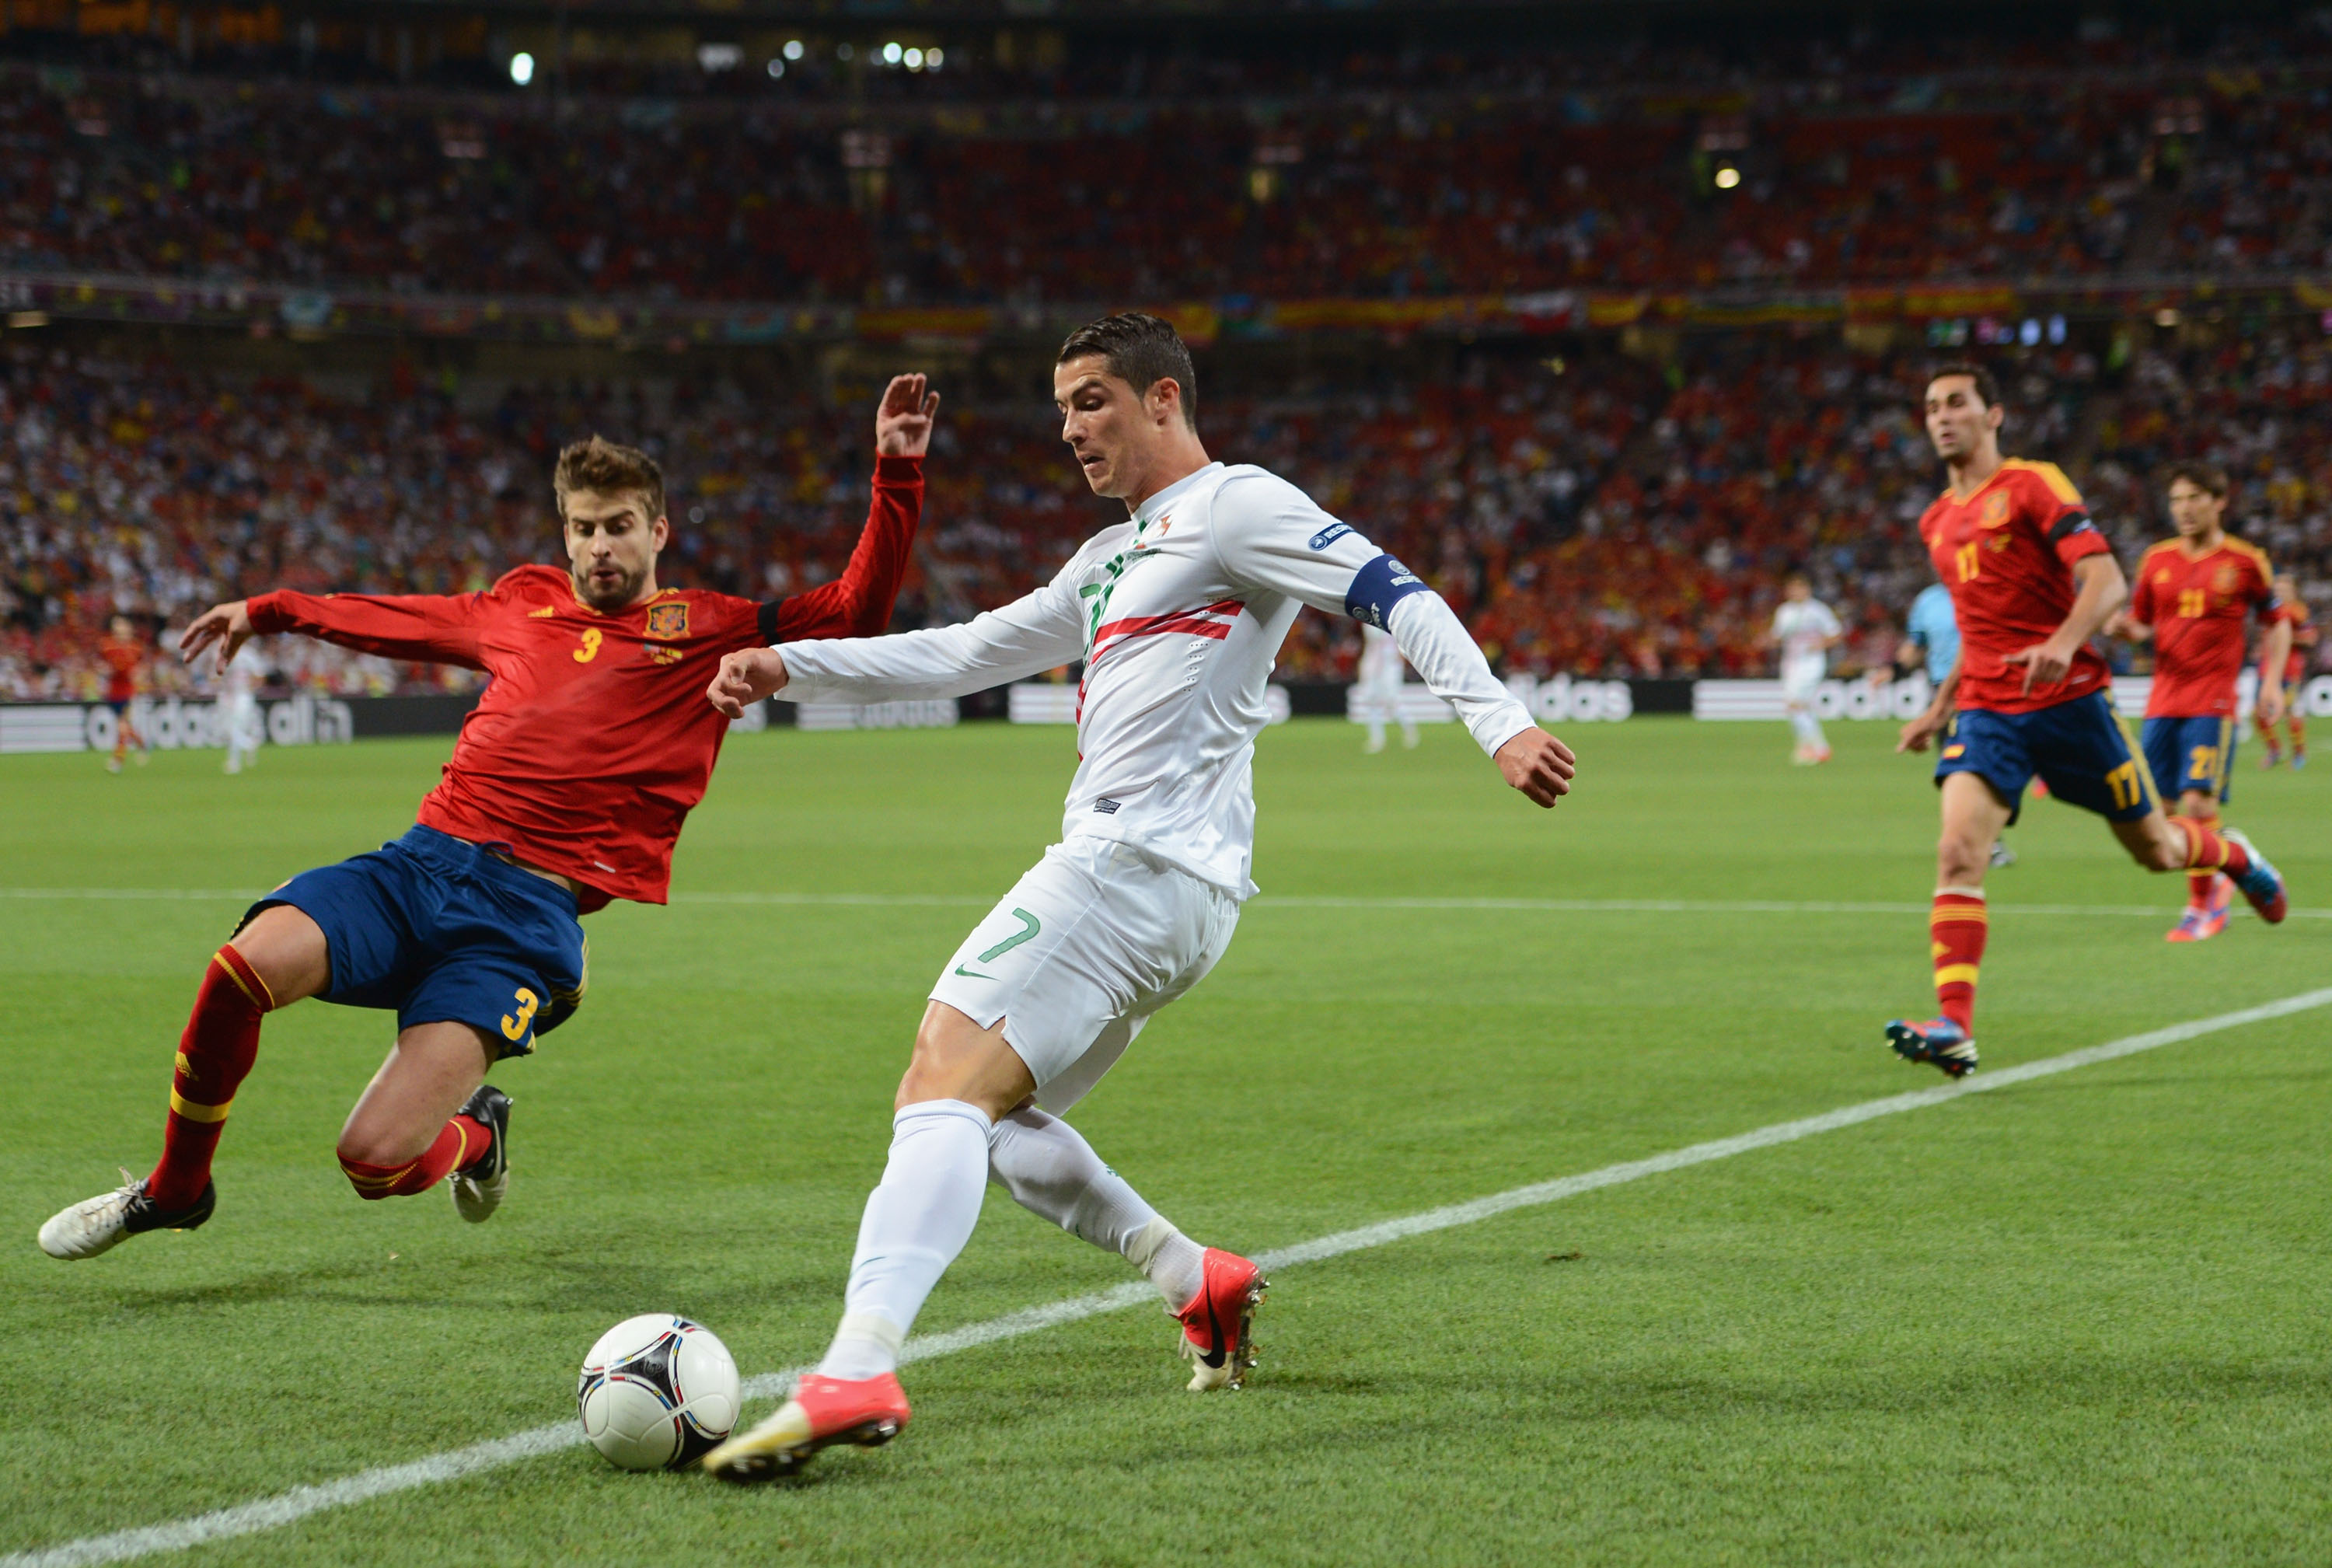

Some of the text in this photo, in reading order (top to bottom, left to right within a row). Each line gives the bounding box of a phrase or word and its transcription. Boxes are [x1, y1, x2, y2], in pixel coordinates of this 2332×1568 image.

[573, 628, 602, 663] 3
[2105, 760, 2141, 811] 17
[978, 907, 1041, 963] 7
[501, 987, 539, 1041] 3
